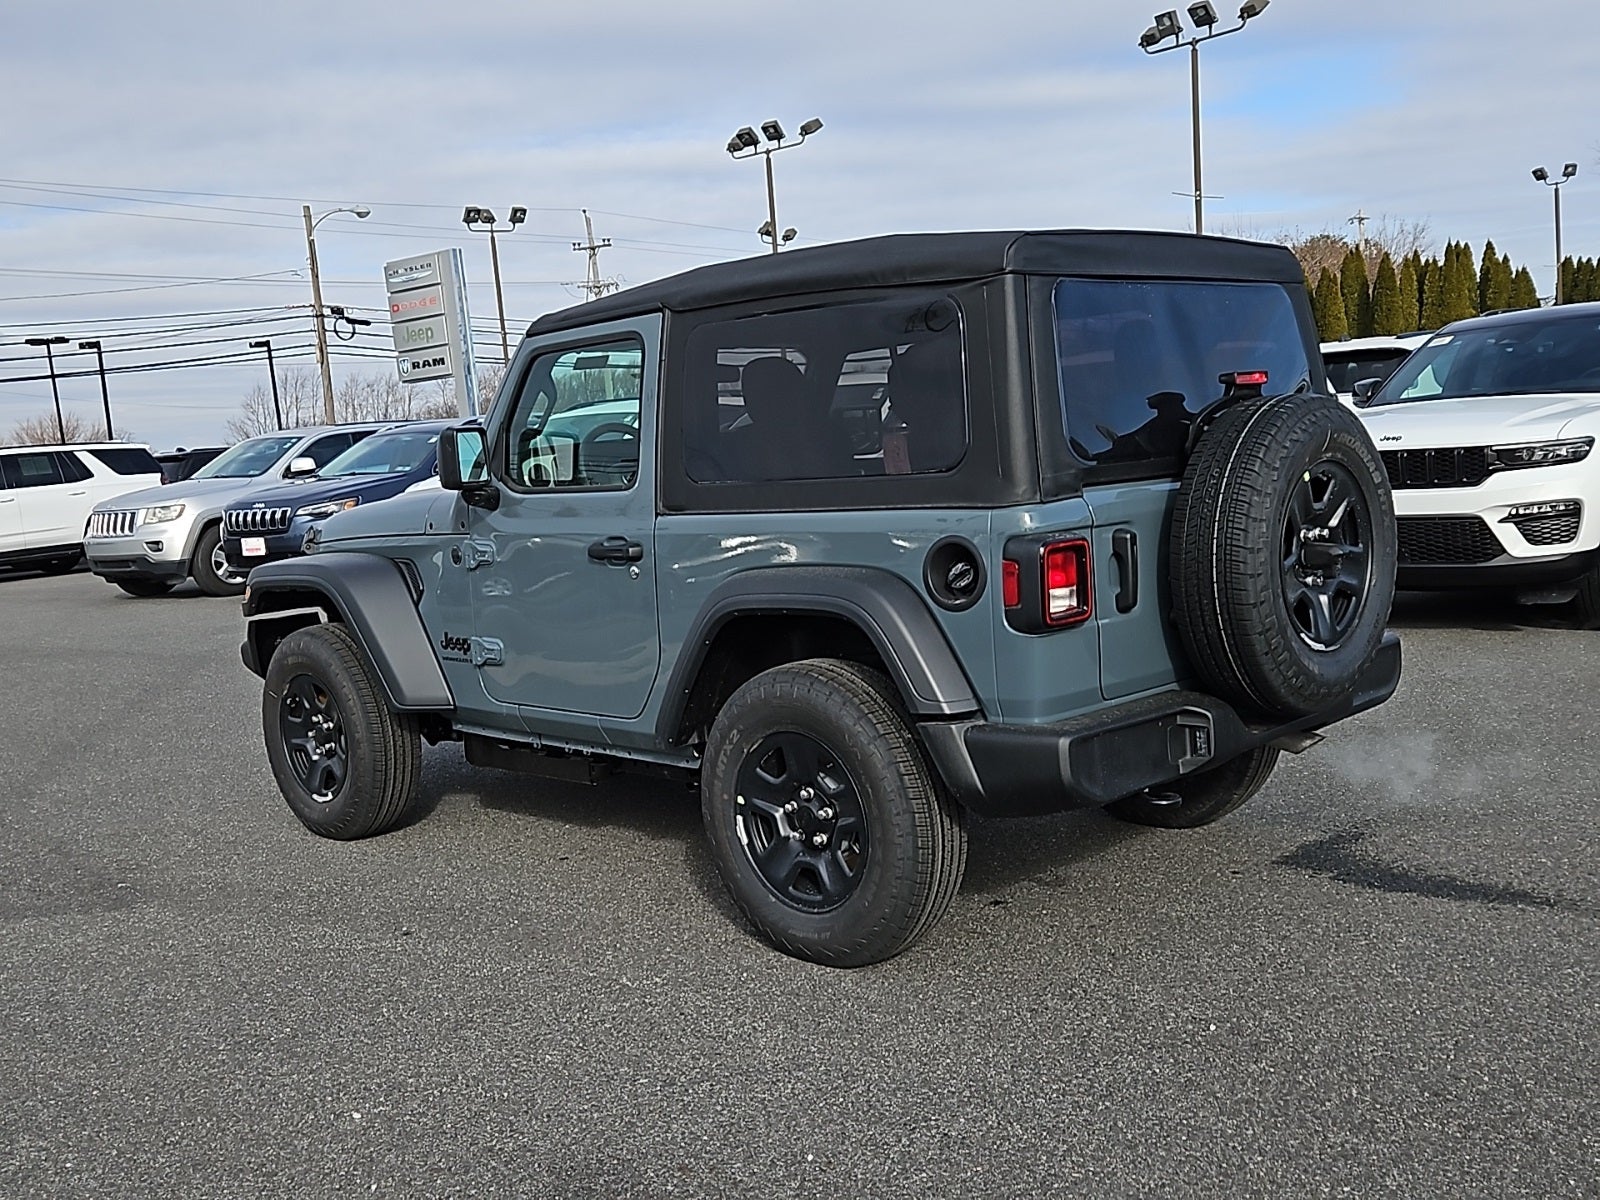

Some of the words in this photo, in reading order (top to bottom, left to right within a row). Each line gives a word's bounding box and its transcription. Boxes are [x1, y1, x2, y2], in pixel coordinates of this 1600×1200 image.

[388, 262, 432, 277] HYSLER
[391, 296, 437, 313] DODGE
[403, 326, 434, 343] Jeep
[411, 357, 446, 370] RAM
[440, 631, 472, 655] Jeep
